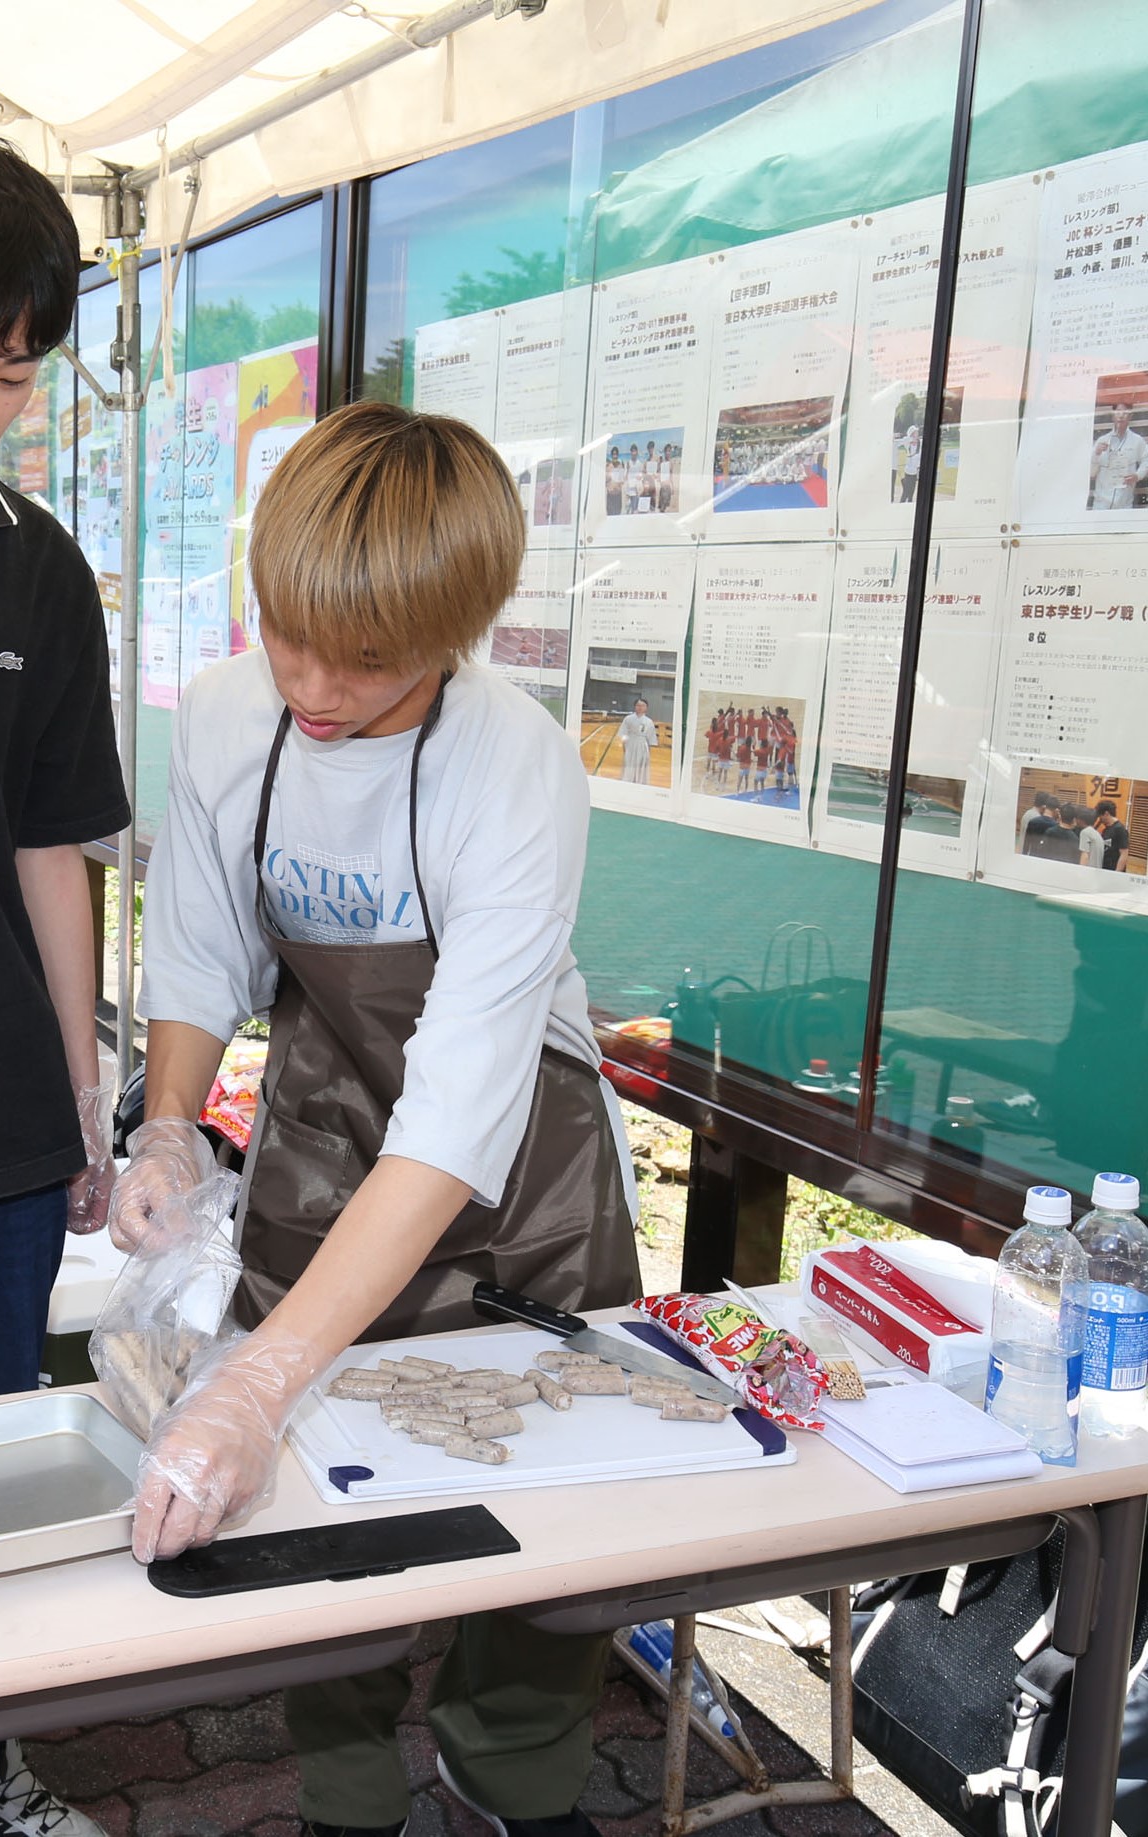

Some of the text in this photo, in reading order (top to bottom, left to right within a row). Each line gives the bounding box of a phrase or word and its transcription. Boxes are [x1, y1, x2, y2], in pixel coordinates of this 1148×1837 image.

[1083, 213, 1148, 240] 杯ジュニアオ
[1022, 584, 1082, 598] 【レスリング部】
